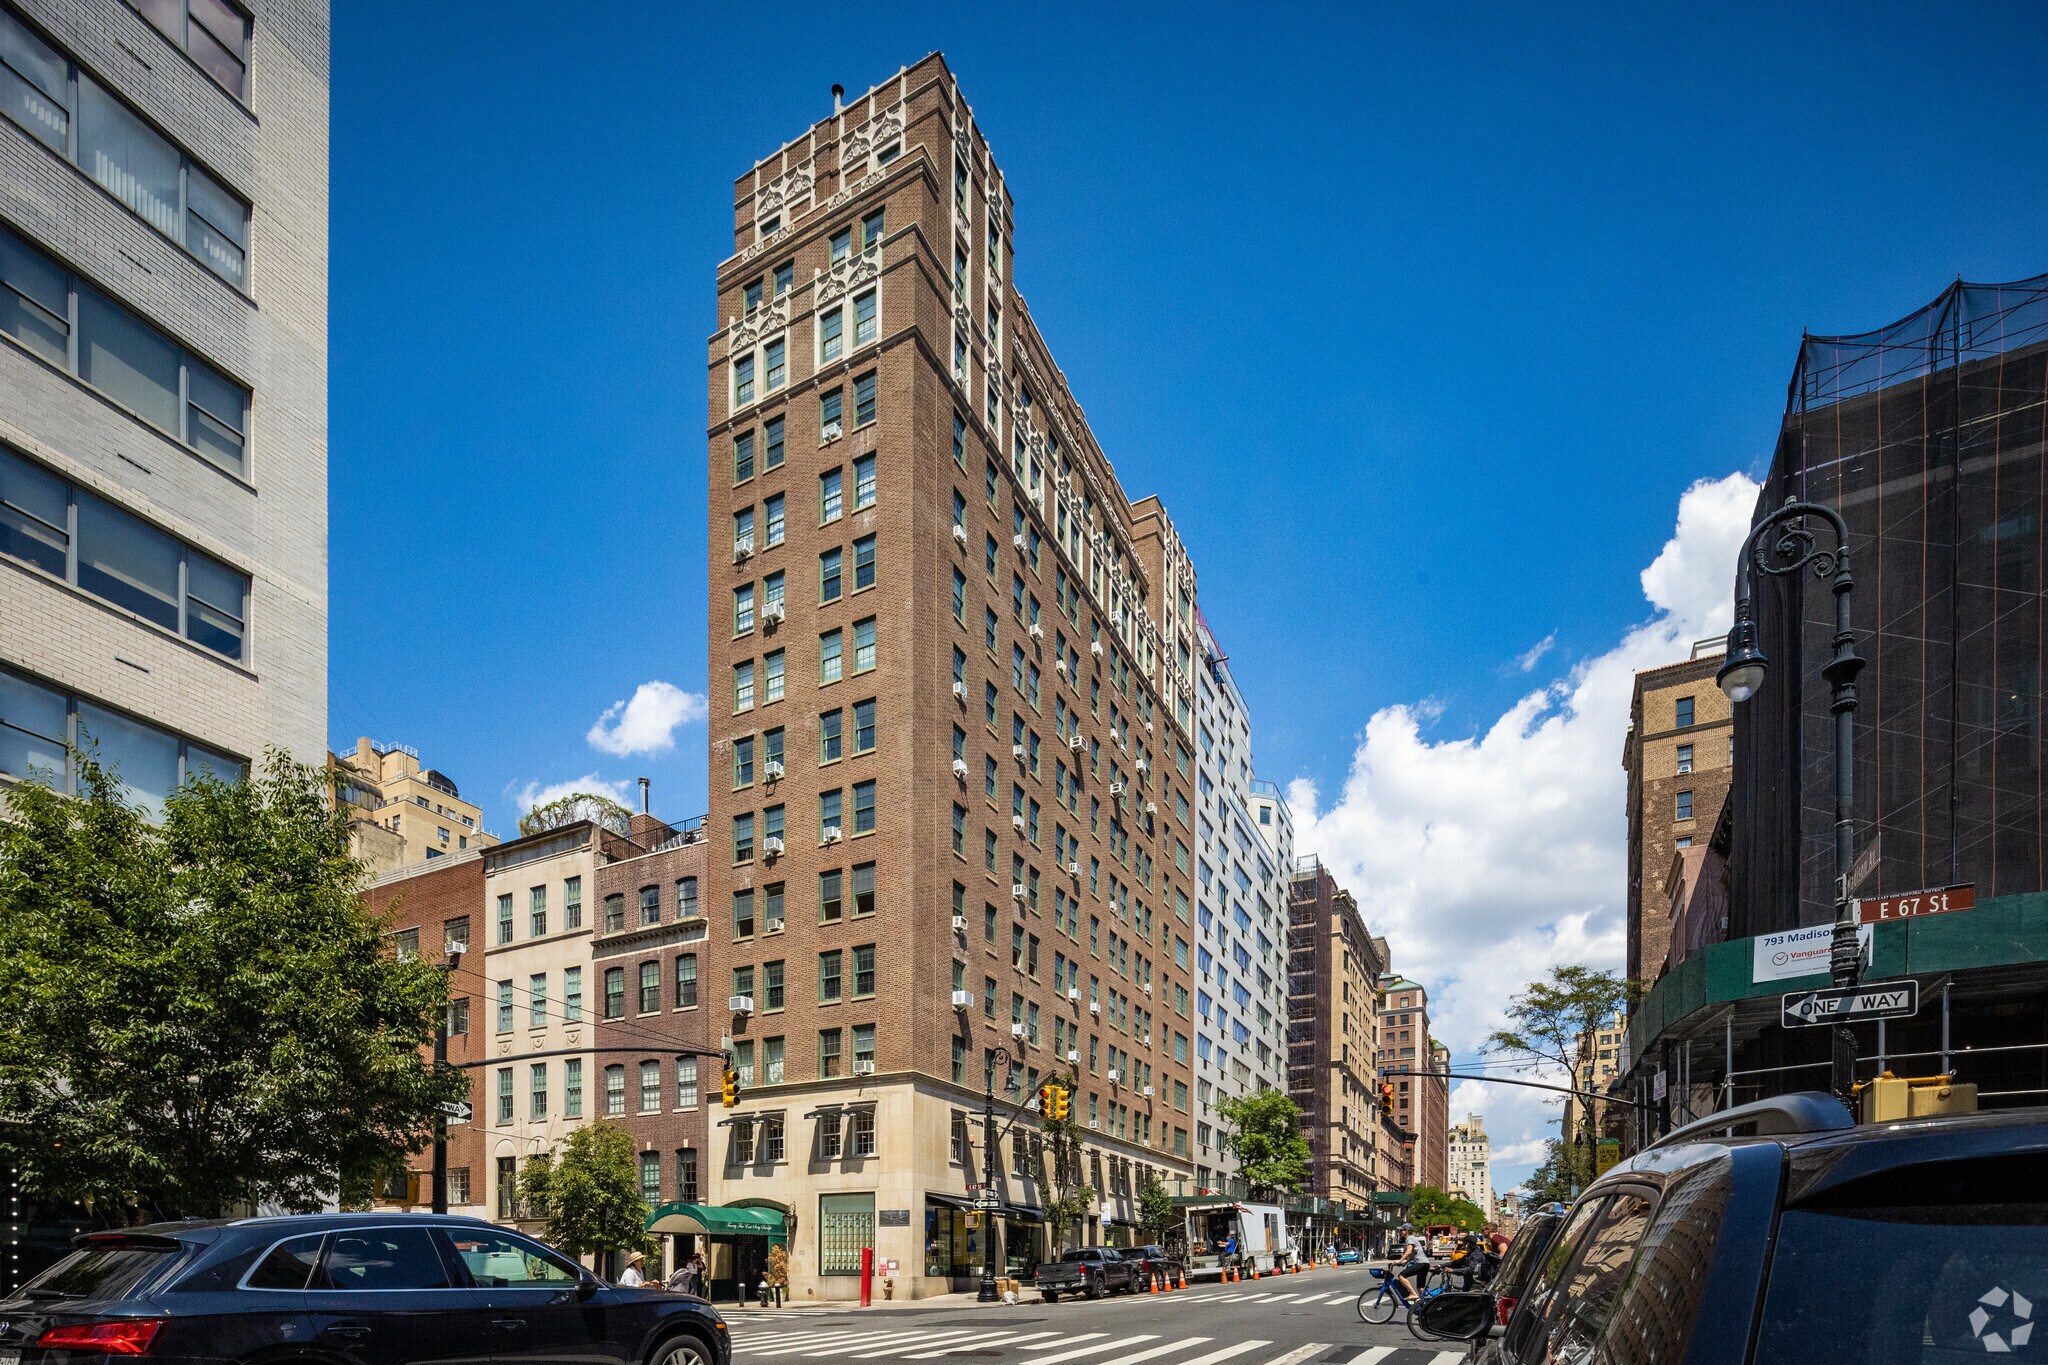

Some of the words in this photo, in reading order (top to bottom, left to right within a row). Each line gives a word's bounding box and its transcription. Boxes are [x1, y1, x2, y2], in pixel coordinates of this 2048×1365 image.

[1880, 902, 1889, 919] E
[1898, 898, 1921, 916] 67
[1929, 893, 1949, 912] St
[1764, 936, 1784, 947] 793
[1800, 999, 1839, 1015] ONE
[1861, 992, 1904, 1010] WAY
[447, 1103, 466, 1114] WAY
